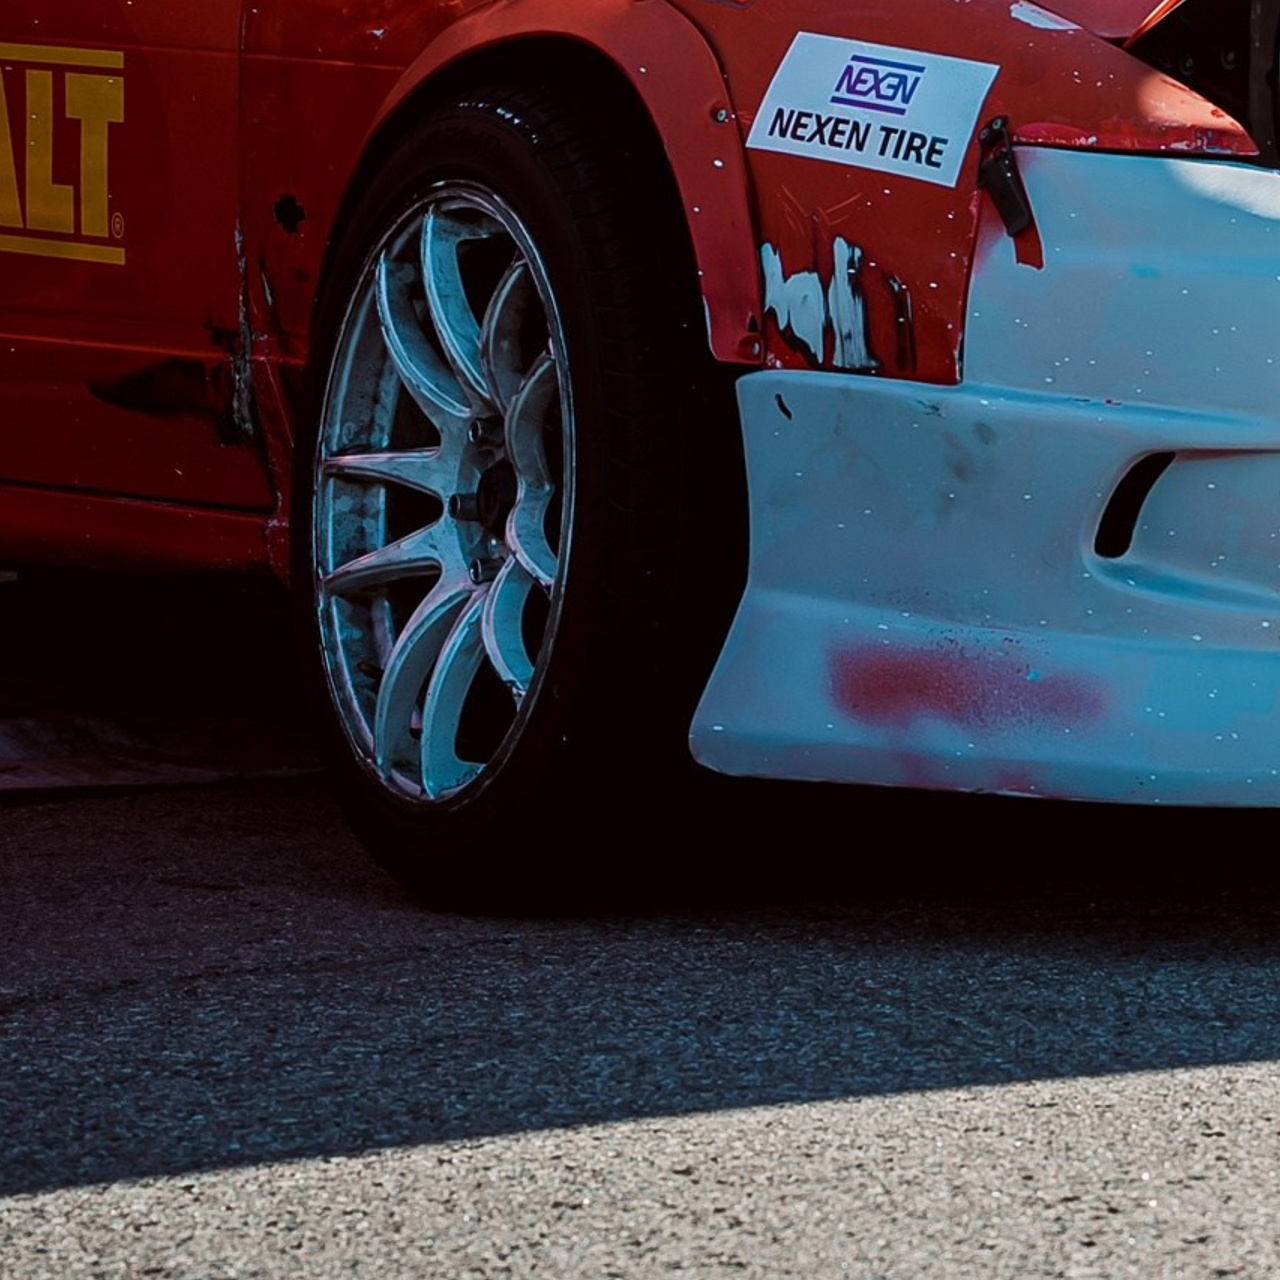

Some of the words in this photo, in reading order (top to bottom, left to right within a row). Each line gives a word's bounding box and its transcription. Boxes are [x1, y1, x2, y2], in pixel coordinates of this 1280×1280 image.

[834, 64, 921, 105] NEXEN
[767, 107, 872, 152] NEXEN
[878, 124, 950, 169] TIRE
